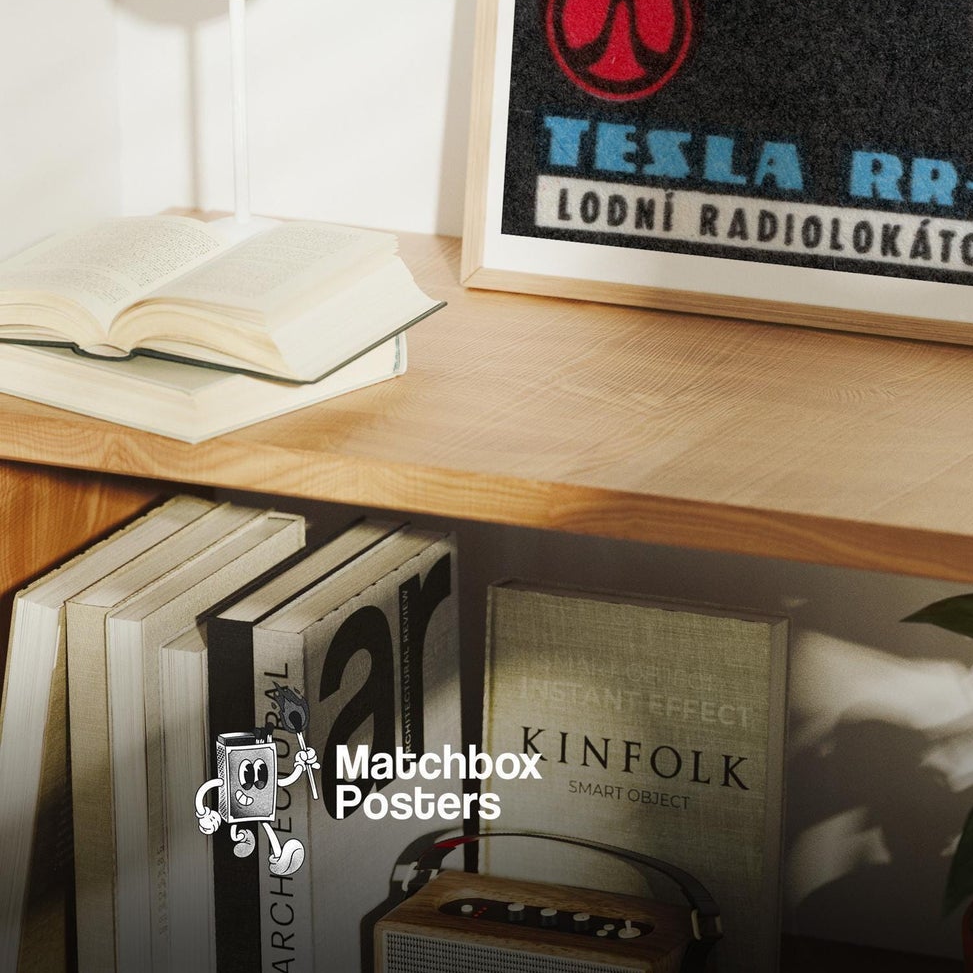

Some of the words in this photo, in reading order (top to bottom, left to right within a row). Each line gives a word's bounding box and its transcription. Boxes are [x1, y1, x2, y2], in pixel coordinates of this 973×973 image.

[544, 116, 803, 190] TESLA
[558, 187, 675, 233] LODNÍ
[649, 694, 748, 728] EFFECT
[521, 726, 750, 791] KINFOLK
[568, 780, 624, 801] SMART
[627, 788, 691, 811] OBJECT
